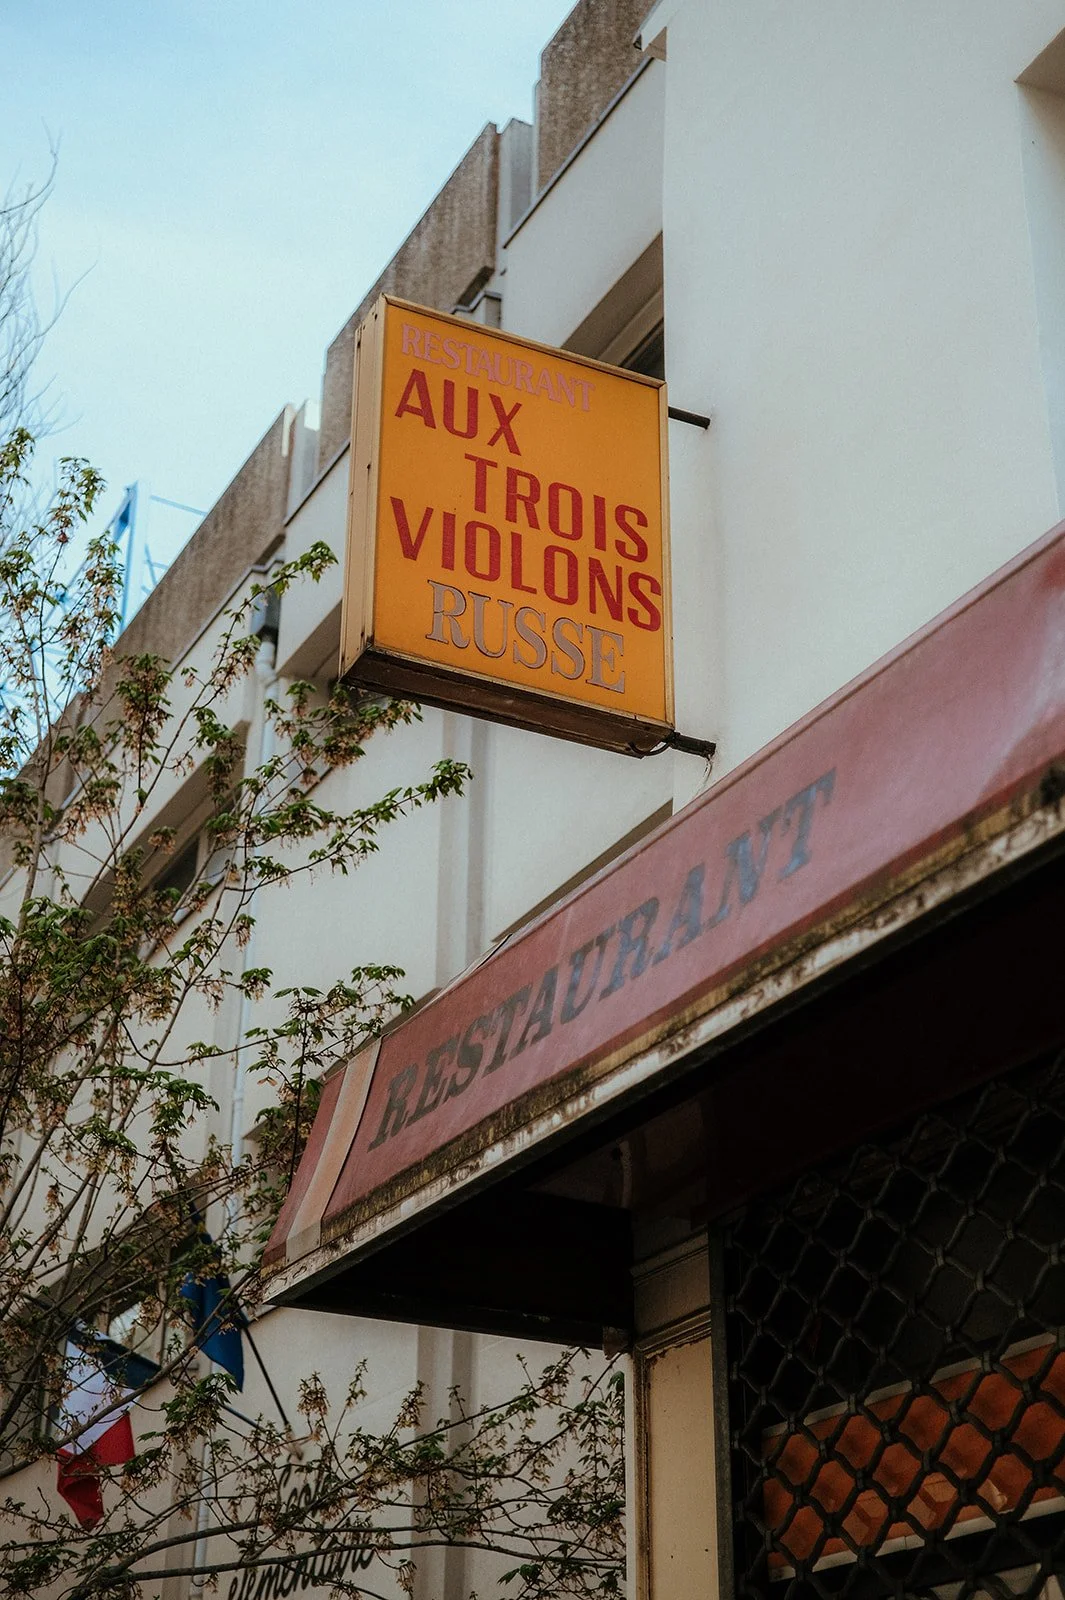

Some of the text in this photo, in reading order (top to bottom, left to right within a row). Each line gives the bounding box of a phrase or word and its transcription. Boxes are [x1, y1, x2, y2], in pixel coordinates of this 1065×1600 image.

[395, 368, 522, 456] AUX
[402, 323, 595, 412] RESTAURANT
[390, 496, 661, 632] VIOLONS
[464, 453, 648, 564] TROIS
[425, 579, 626, 694] RUSSE
[367, 768, 836, 1153] RESTAURANT
